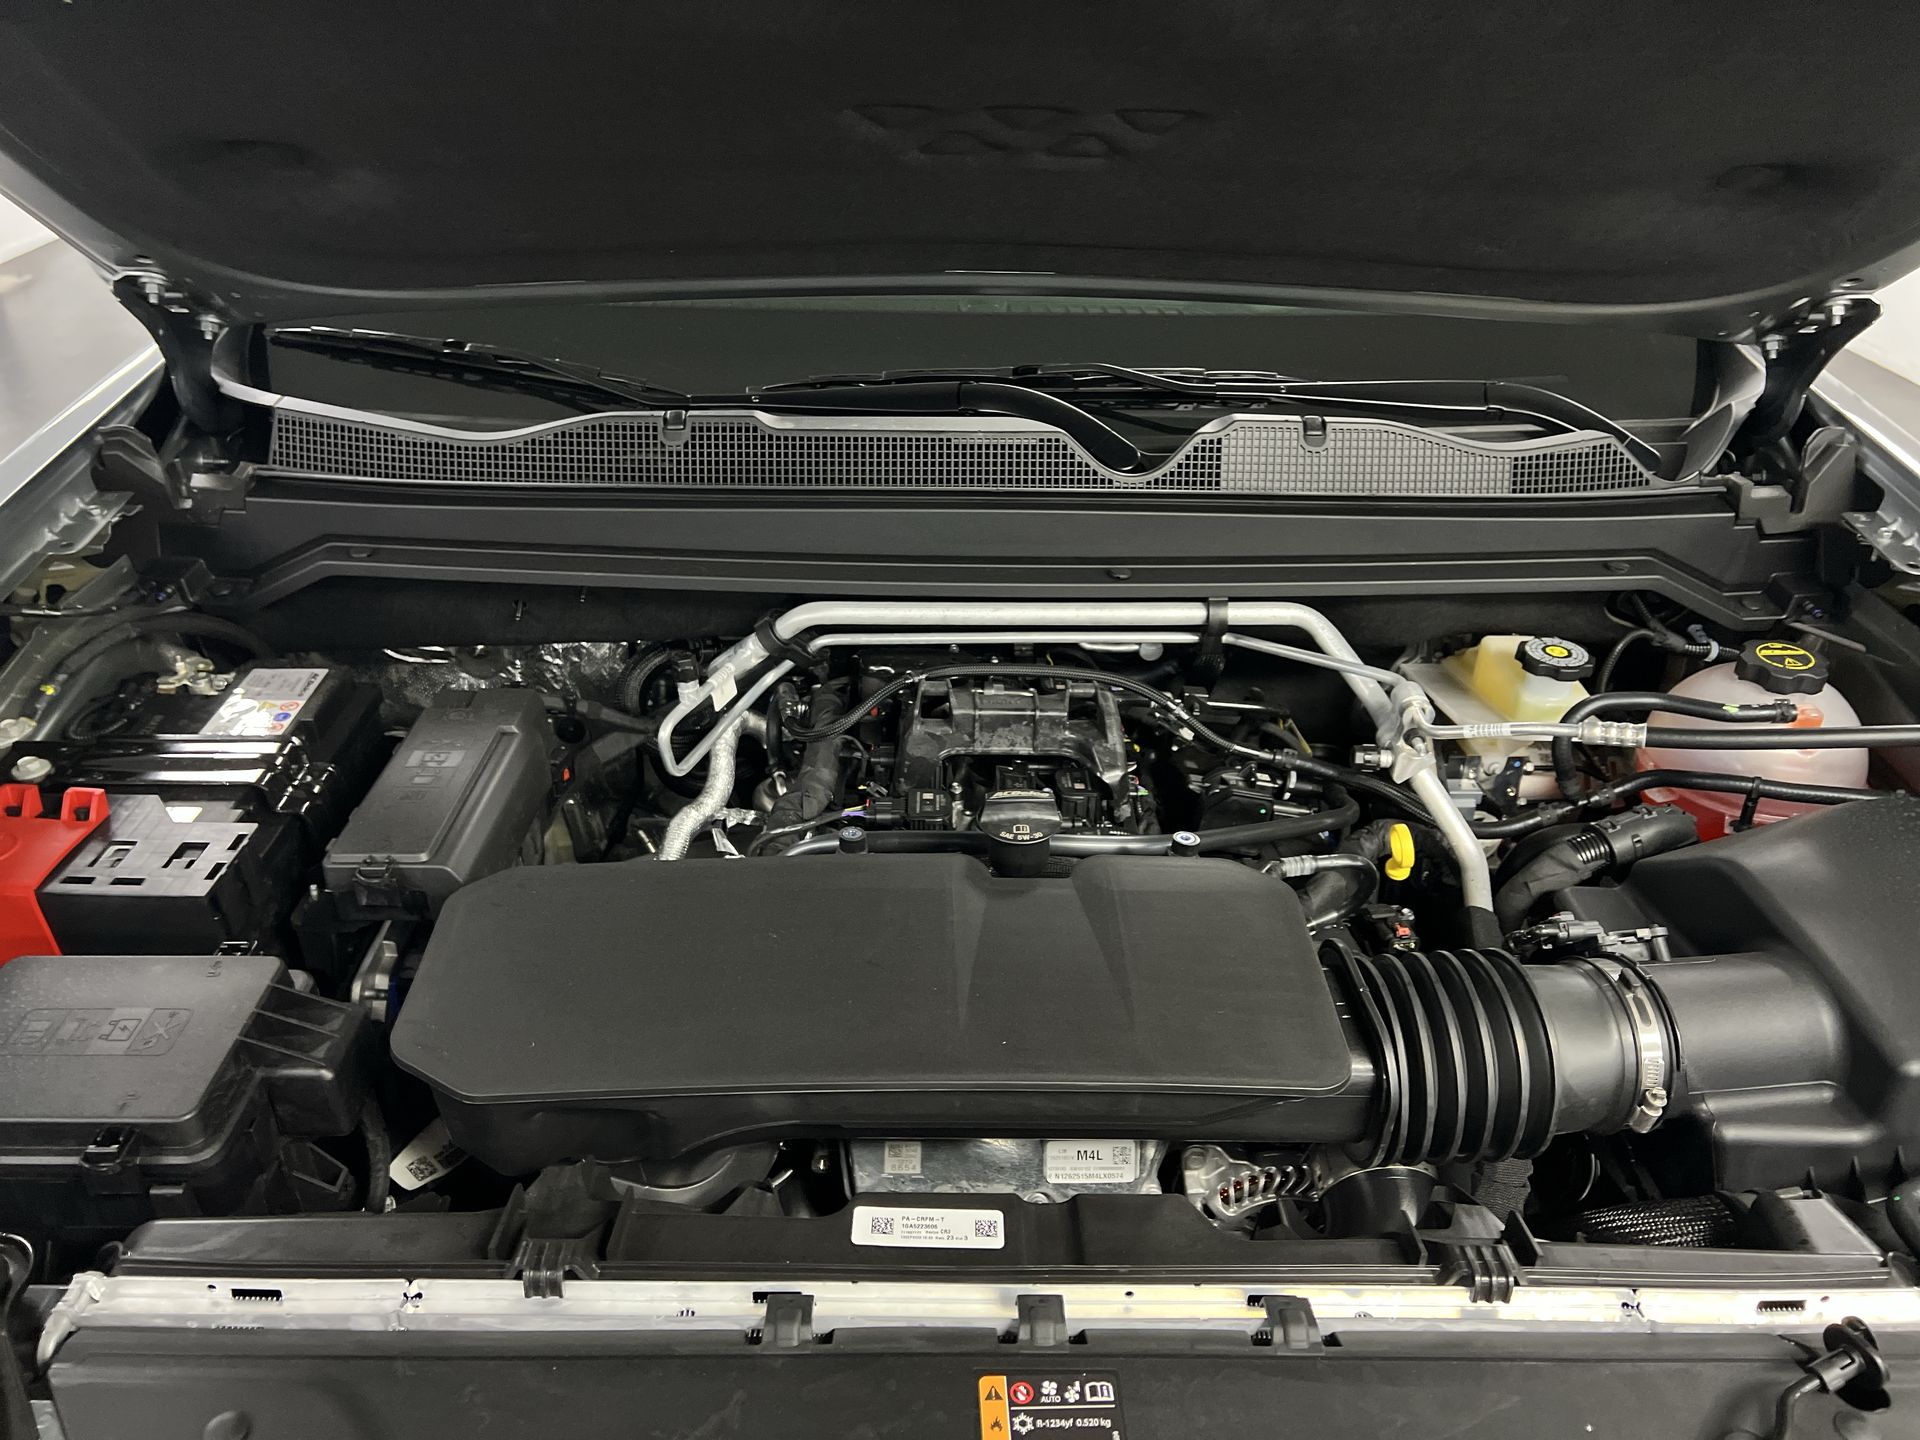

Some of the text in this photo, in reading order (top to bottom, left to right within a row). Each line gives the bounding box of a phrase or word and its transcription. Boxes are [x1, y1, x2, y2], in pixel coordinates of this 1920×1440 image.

[999, 831, 1044, 841] SAE 5W-30
[1076, 1149, 1103, 1161] M4L
[1040, 1395, 1061, 1403] AUTO
[1036, 1417, 1111, 1429] R-1234yf 0.520 kg
